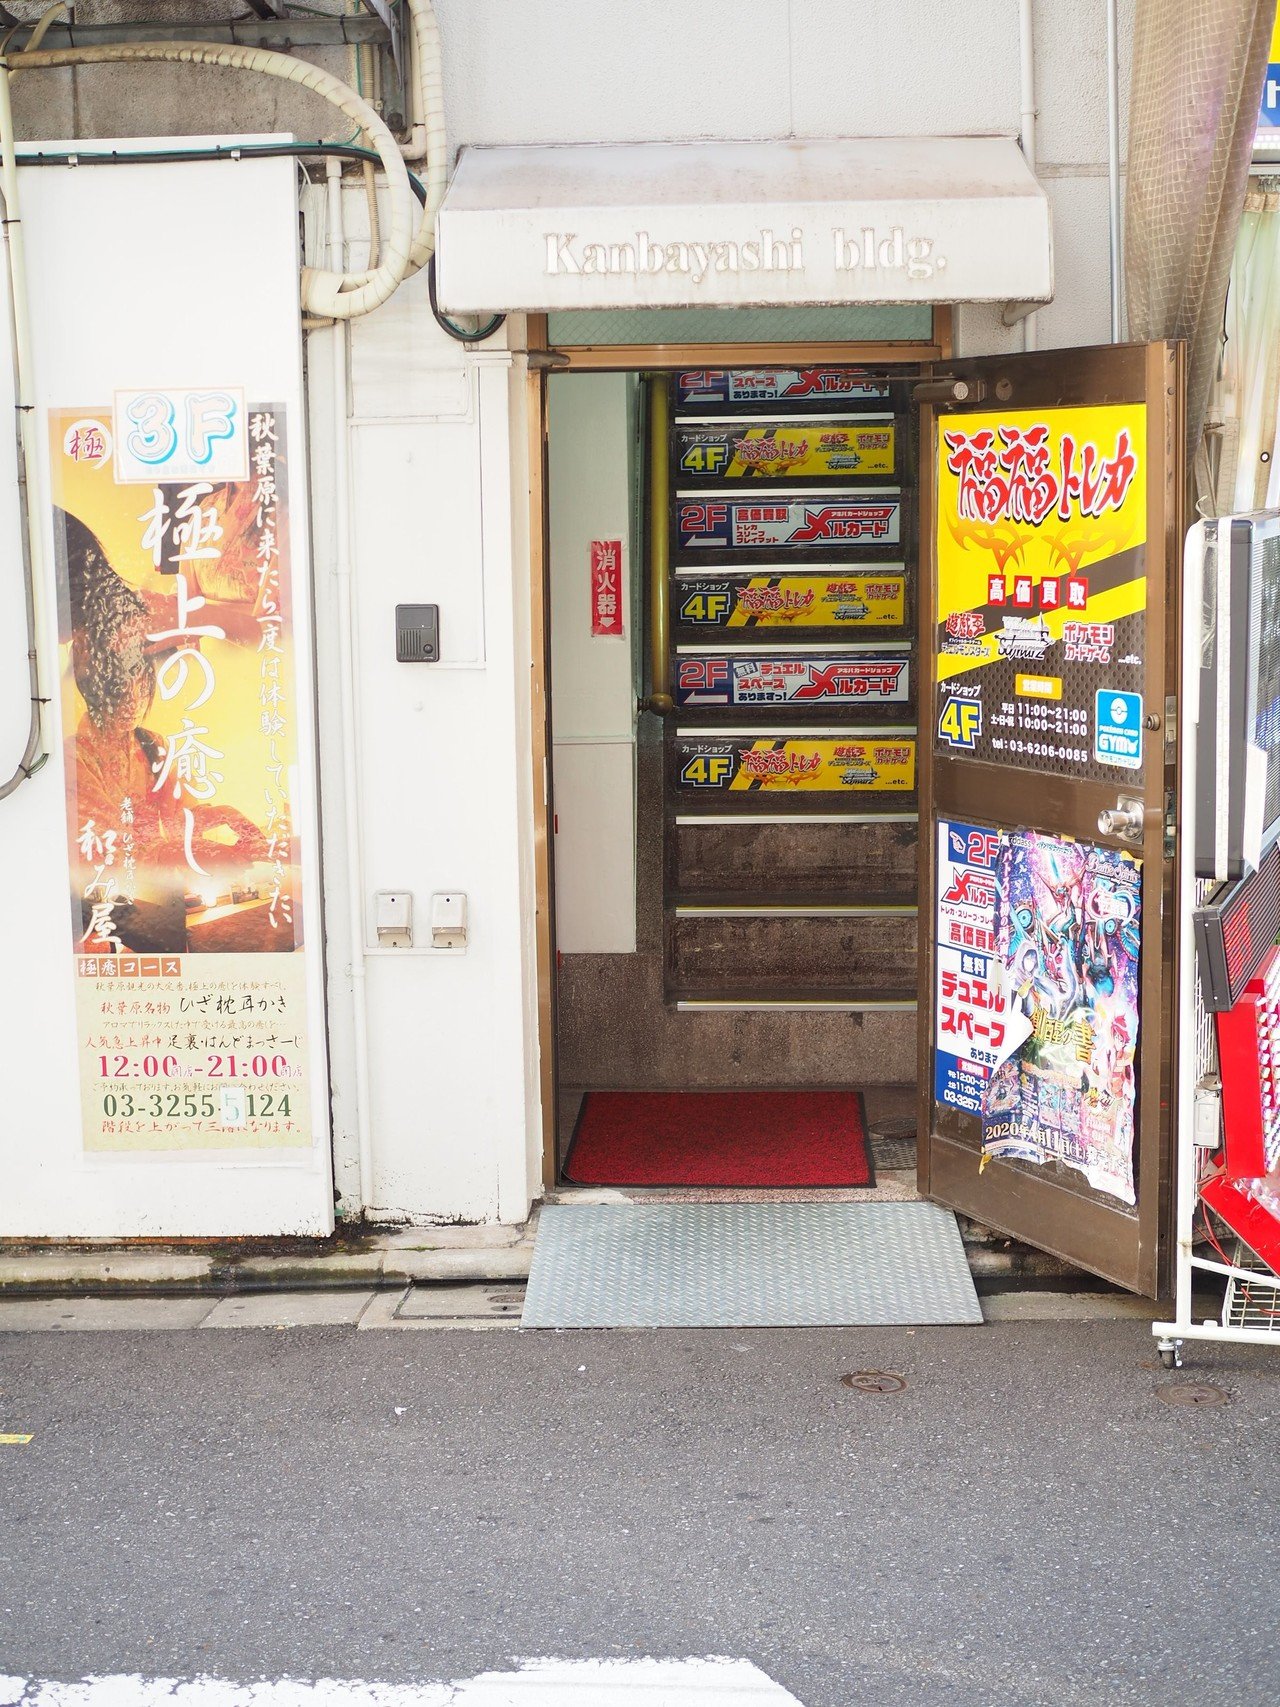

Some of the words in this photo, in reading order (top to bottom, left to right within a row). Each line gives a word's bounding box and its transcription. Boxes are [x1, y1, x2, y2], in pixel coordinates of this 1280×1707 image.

[543, 228, 806, 284] Kanbayashi
[832, 225, 947, 280] bldg.
[731, 377, 778, 389] スペース
[127, 392, 237, 465] 3F
[681, 433, 728, 443] カードショップ
[856, 433, 891, 443] ポケモン
[69, 427, 104, 461] 極
[733, 437, 810, 462] 福福トレカ
[681, 444, 728, 474] 4F
[944, 423, 1138, 528] 福福トレカ
[681, 505, 728, 532] 2F
[736, 508, 788, 522] 高価買取
[787, 507, 889, 541] メルカード
[596, 549, 617, 615] 消火器
[681, 582, 729, 591] カードショップ
[864, 583, 900, 593] ポケモン
[988, 577, 1086, 607] 高価買取
[682, 593, 730, 623] 4F
[735, 586, 816, 611] 福福トレカ
[946, 613, 987, 639] 遊戯王
[1062, 622, 1115, 647] ポケモン
[1065, 645, 1111, 663] カードゲーム
[137, 483, 226, 877] 極上の癒し
[248, 412, 293, 929] 秋葉原に来たら一度は体験していただきたい
[680, 661, 729, 689] 2F
[760, 662, 807, 676] デュエル
[737, 677, 787, 690] スペース
[790, 664, 897, 700] メルカード
[941, 682, 981, 697] カードショップ
[738, 692, 788, 702] ありますっ!
[1001, 702, 1015, 714] 平日
[938, 697, 983, 749] 4F
[682, 745, 732, 753] カードショップ
[738, 749, 822, 774] 福福トレカ
[833, 746, 866, 757] 遊戯王
[873, 747, 911, 758] ポケモン
[875, 757, 908, 765] カードゲーム
[1010, 741, 1087, 762] 03-6206-0085
[681, 755, 733, 787] 4F
[967, 832, 999, 867] 2F
[76, 819, 123, 954] 和み屋
[79, 957, 179, 976] 極癒コース
[962, 955, 986, 977] 無料
[941, 970, 1006, 1011] デュエル
[100, 1001, 171, 1015] 秋葉原名物
[180, 994, 288, 1014] ひざ枕耳かき
[84, 1036, 163, 1049] 人気急上昇中
[103, 1094, 292, 1122] 03-32555124
